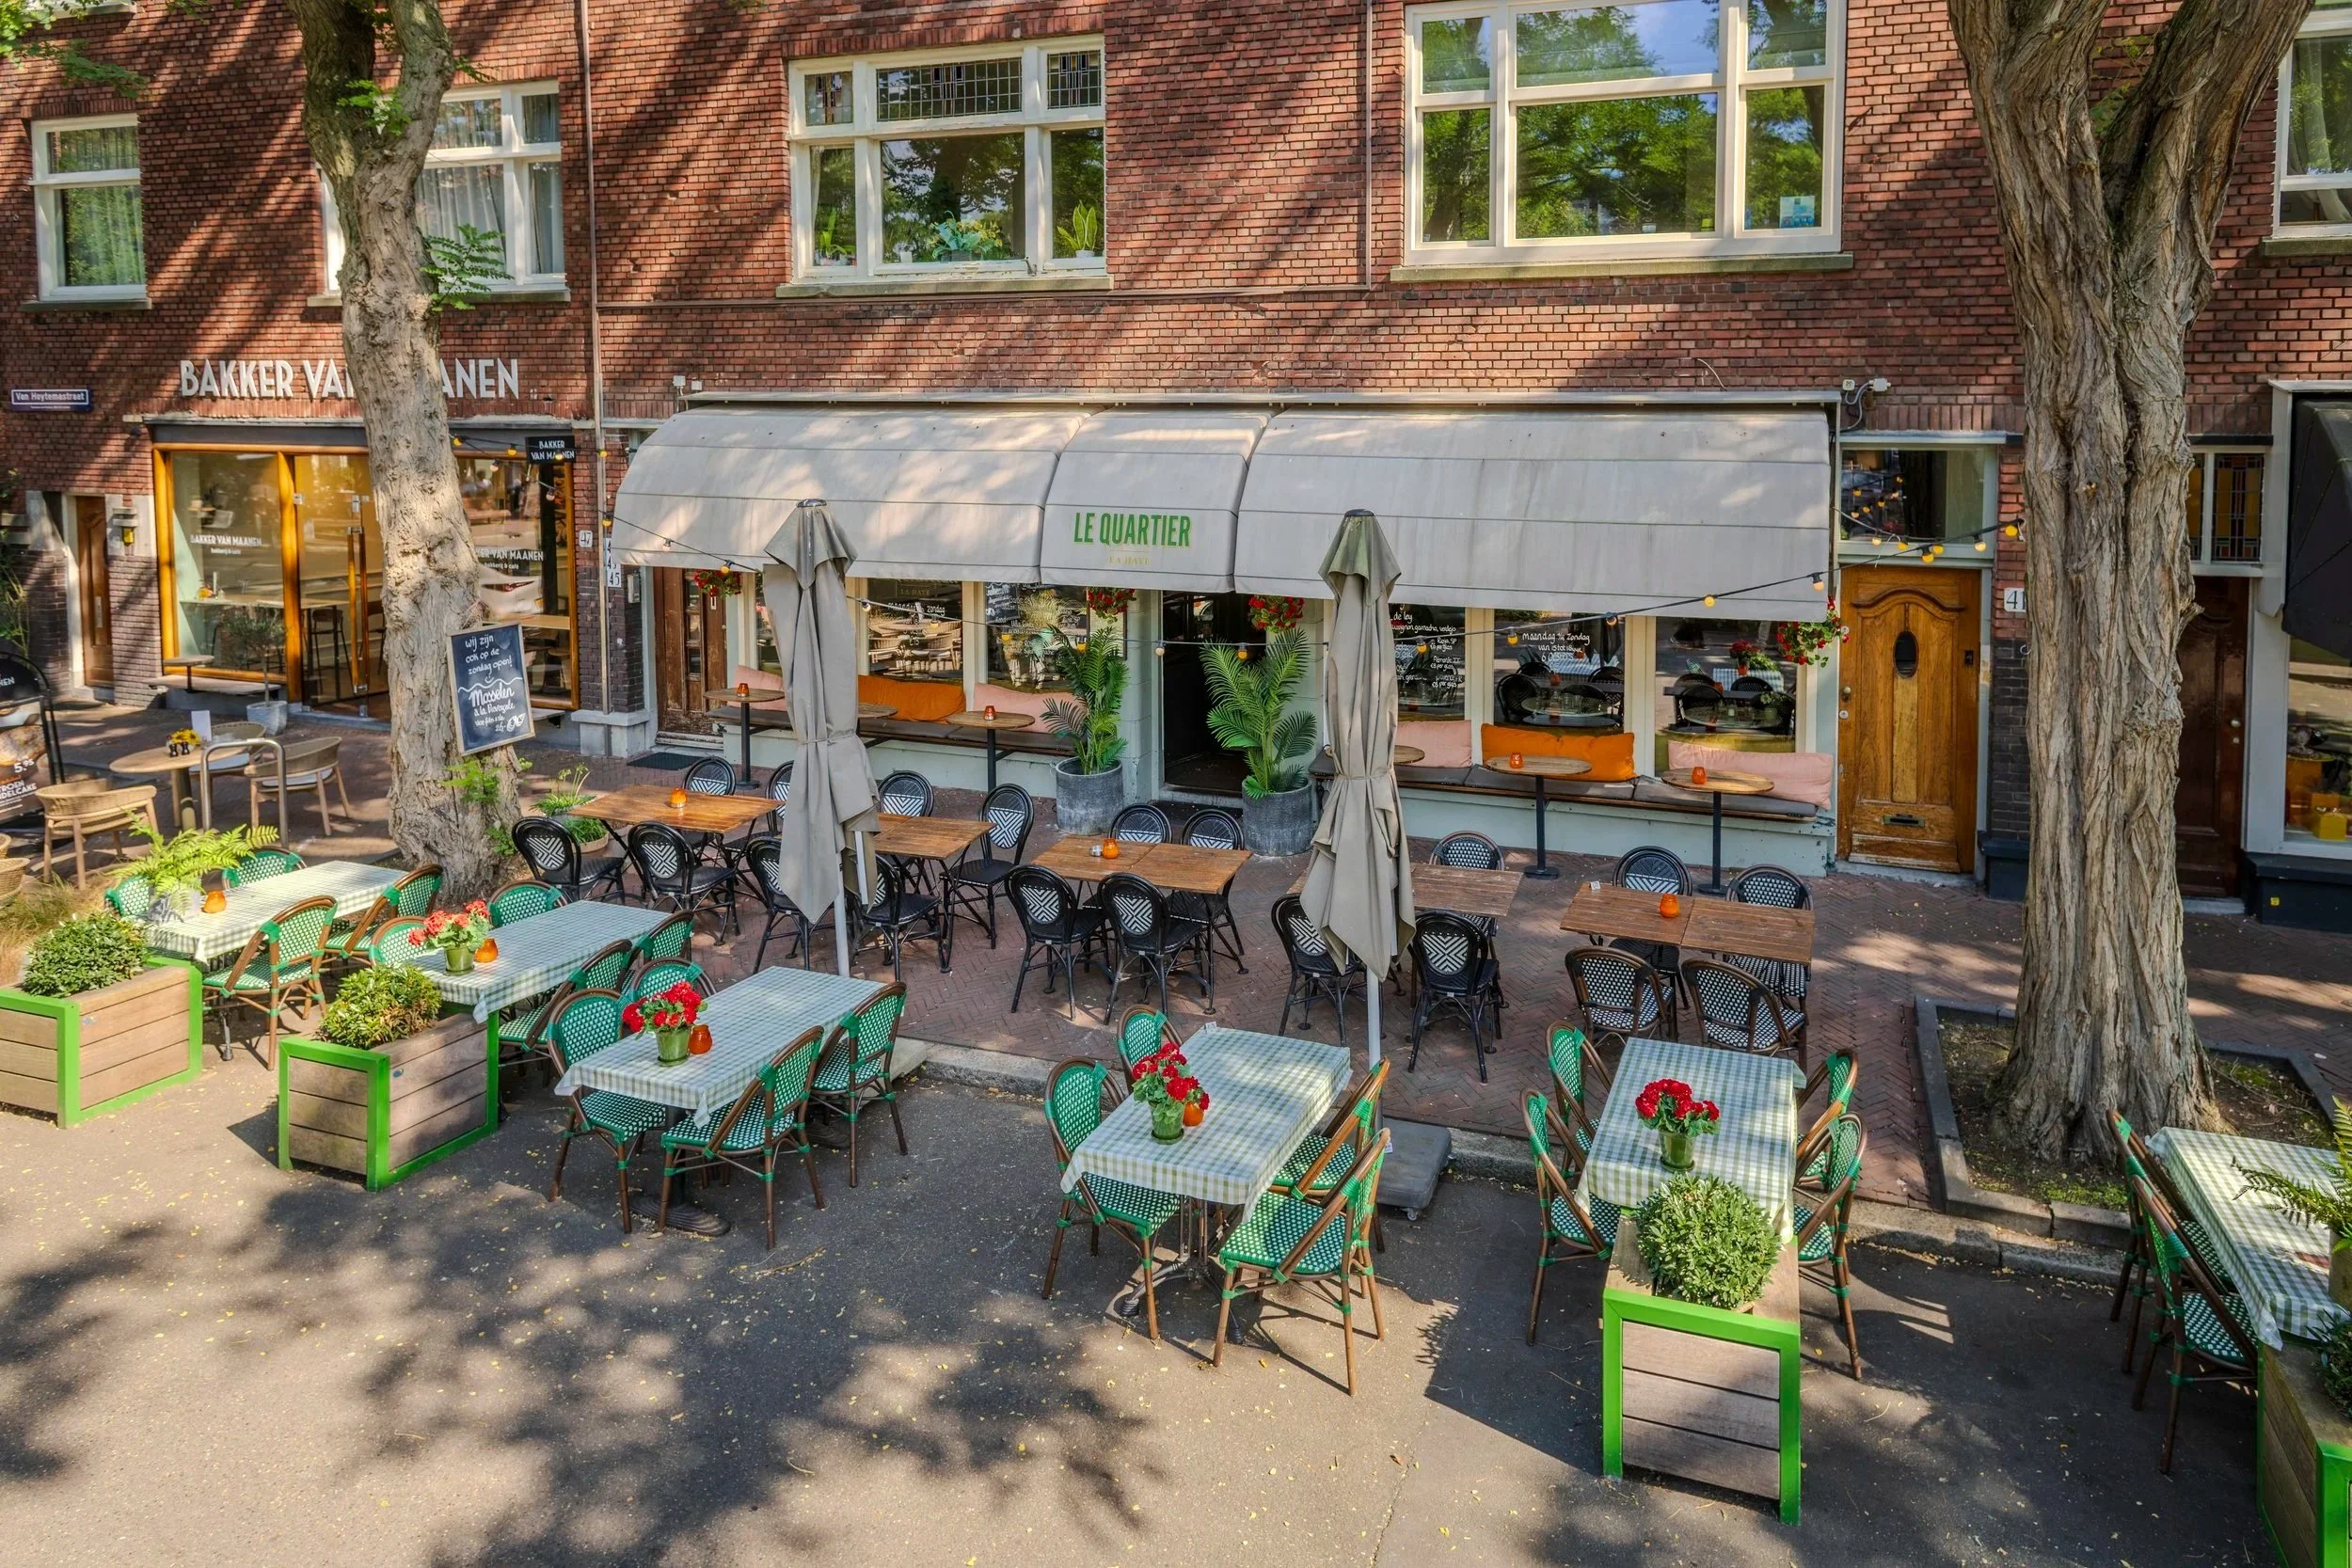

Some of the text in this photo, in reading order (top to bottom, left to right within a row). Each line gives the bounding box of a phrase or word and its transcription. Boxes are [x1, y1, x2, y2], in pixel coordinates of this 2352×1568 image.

[180, 359, 294, 398] BAKKER
[439, 357, 519, 399] ANEN
[15, 392, 29, 401] Van
[539, 440, 564, 449] BAKKER
[531, 451, 575, 460] VAN MANEN
[1074, 512, 1191, 546] LE QUARTIER
[190, 534, 262, 546] BAKKER VAN MAANEN
[580, 531, 591, 545] 47
[492, 549, 508, 559] VAN
[509, 549, 544, 561] MAANEN
[609, 572, 620, 586] 45
[2006, 590, 2026, 610] 41
[466, 654, 479, 663] ook
[468, 655, 513, 677] zondag open!
